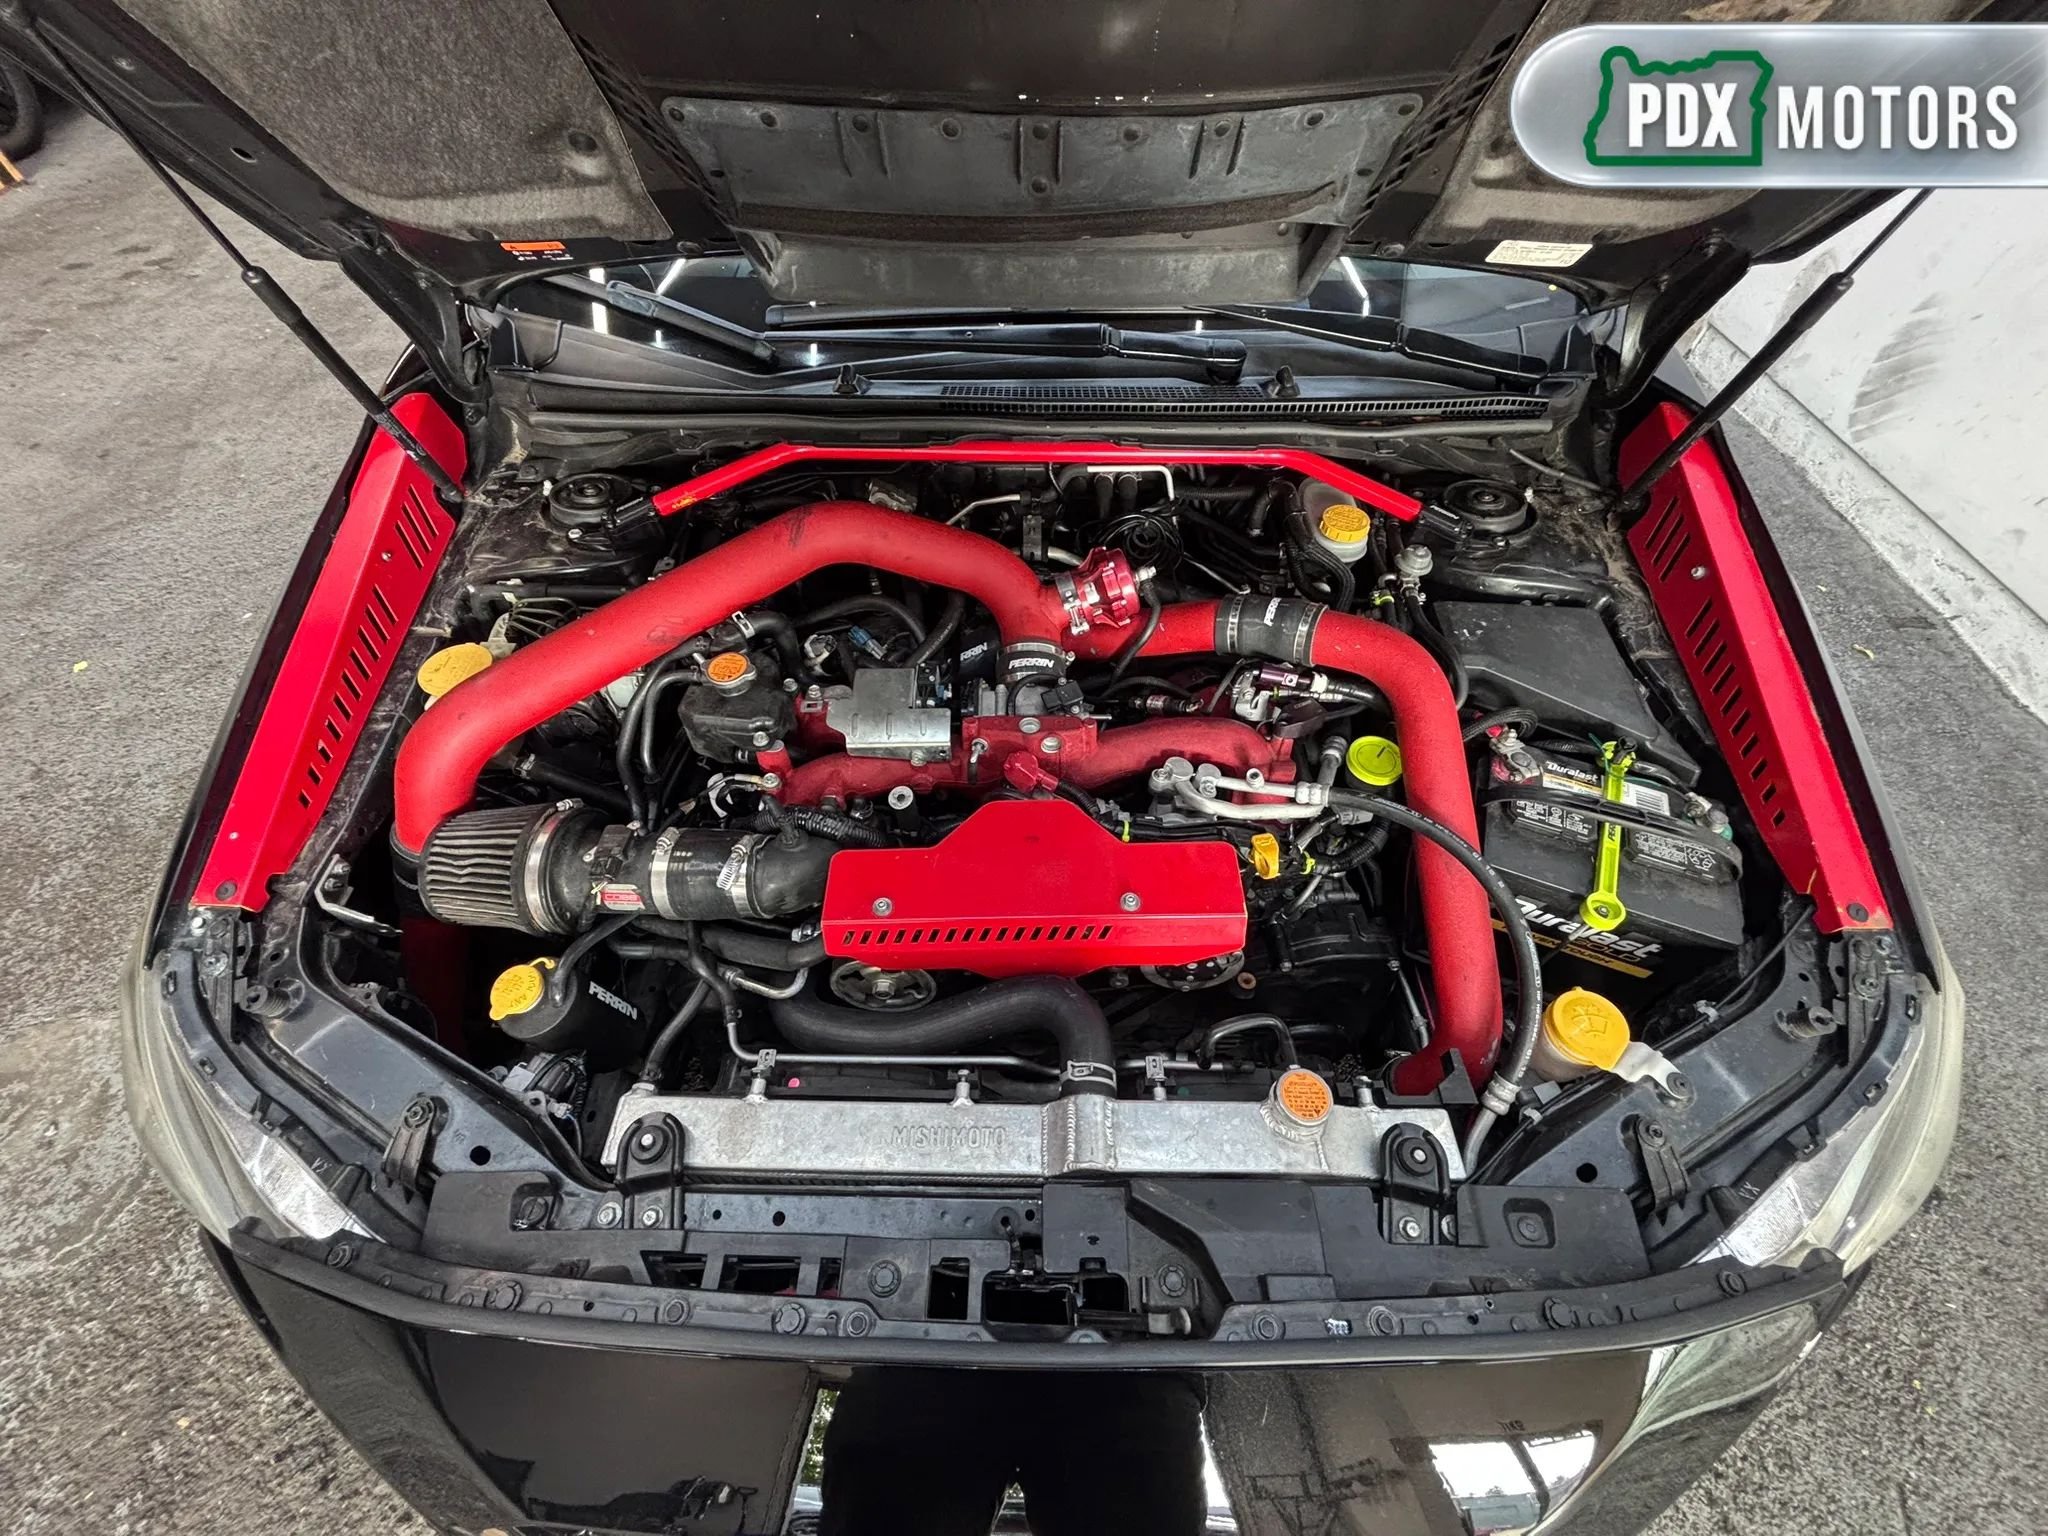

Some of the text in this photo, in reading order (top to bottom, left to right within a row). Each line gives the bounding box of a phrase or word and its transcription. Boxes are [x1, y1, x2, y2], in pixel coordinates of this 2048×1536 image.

[1263, 597, 1282, 627] PERR
[1008, 657, 1054, 669] PERRIN
[1546, 760, 1599, 782] Duralast
[1607, 823, 1617, 842] PER
[588, 980, 638, 1021] PERRIN
[891, 1125, 1007, 1149] MISHIMOTO
